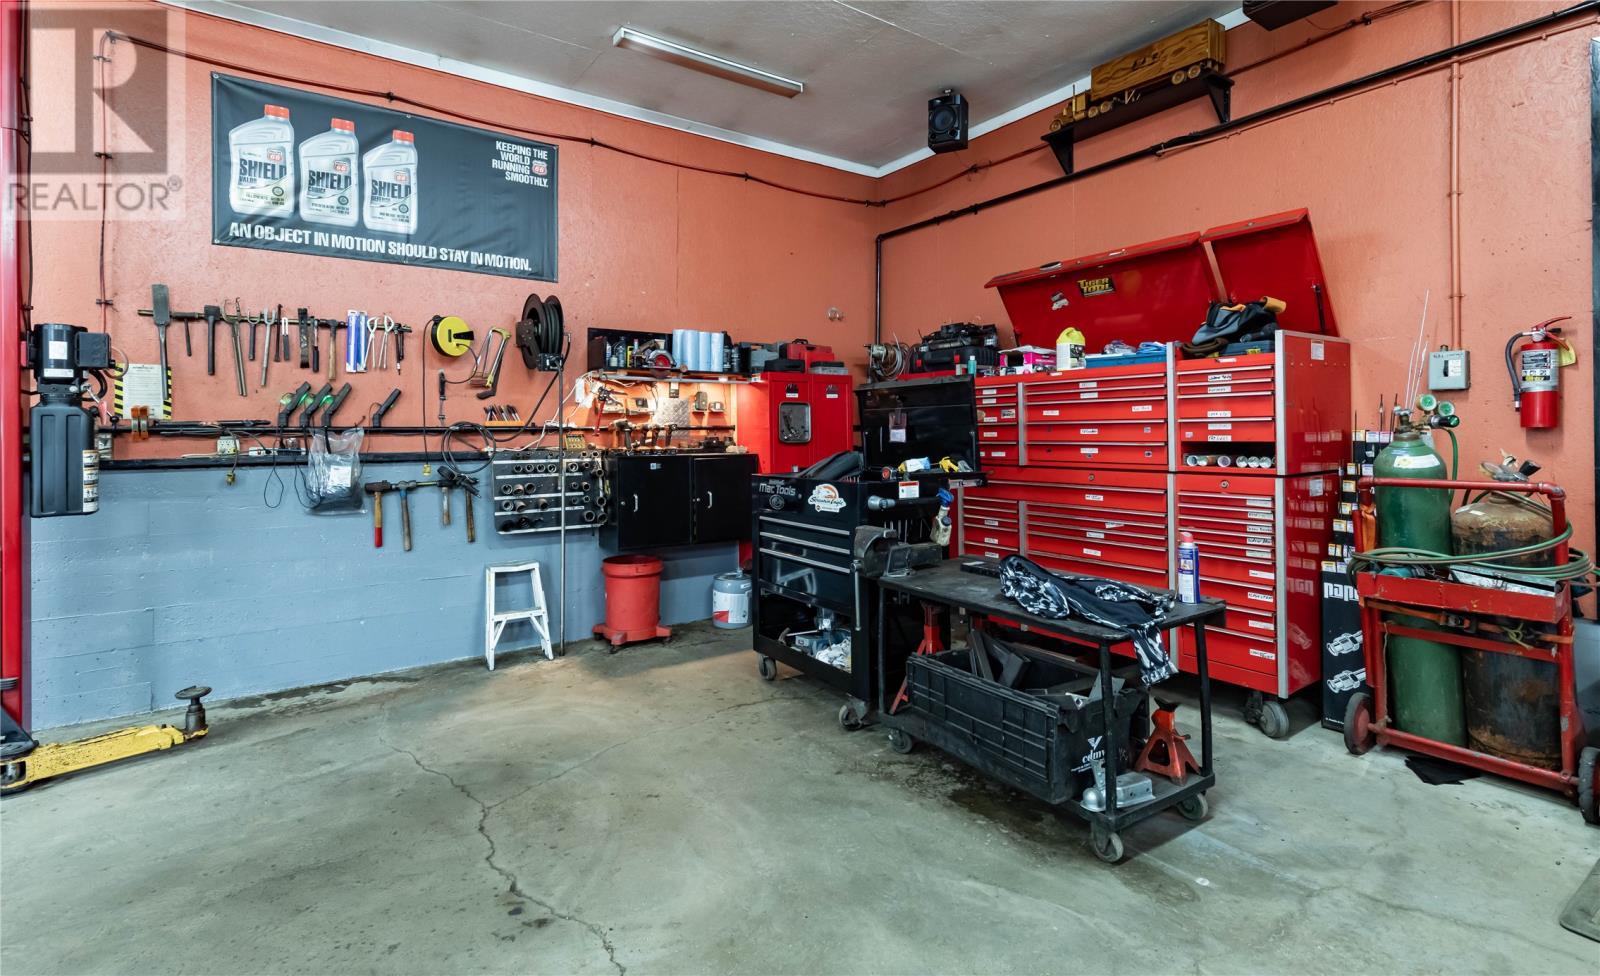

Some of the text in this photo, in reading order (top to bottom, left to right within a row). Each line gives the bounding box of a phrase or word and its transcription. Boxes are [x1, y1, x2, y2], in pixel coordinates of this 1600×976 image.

[496, 141, 548, 160] KEEPING THE
[500, 151, 530, 165] WORLD
[492, 159, 530, 174] RUNNING
[505, 171, 548, 187] SMOOTHLY.
[229, 222, 532, 271] AN OBJECT IN MOTION SHOULD STAY IN MOTION.
[759, 483, 795, 496] Mac Tools
